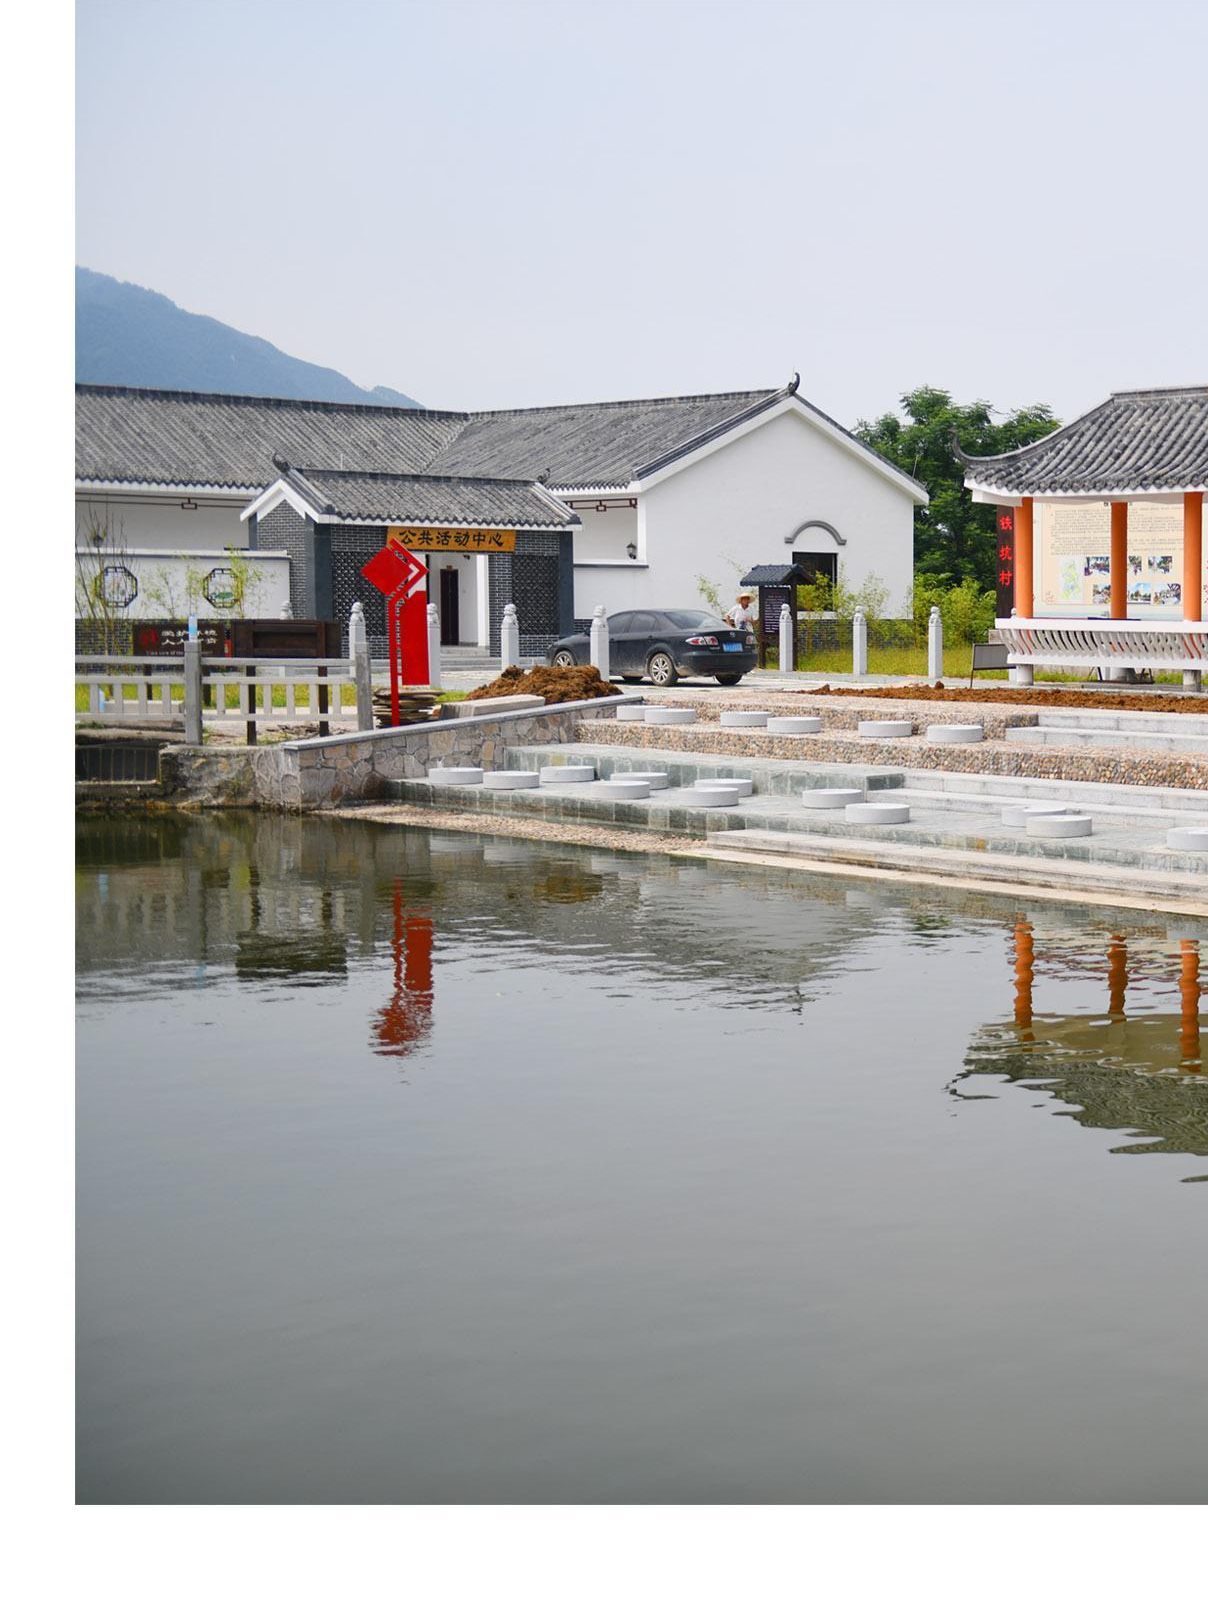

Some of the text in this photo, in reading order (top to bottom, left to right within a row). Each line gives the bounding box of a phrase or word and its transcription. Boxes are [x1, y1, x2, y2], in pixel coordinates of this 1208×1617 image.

[398, 529, 504, 547] 公共活动中心
[999, 515, 1013, 586] 铁坑村
